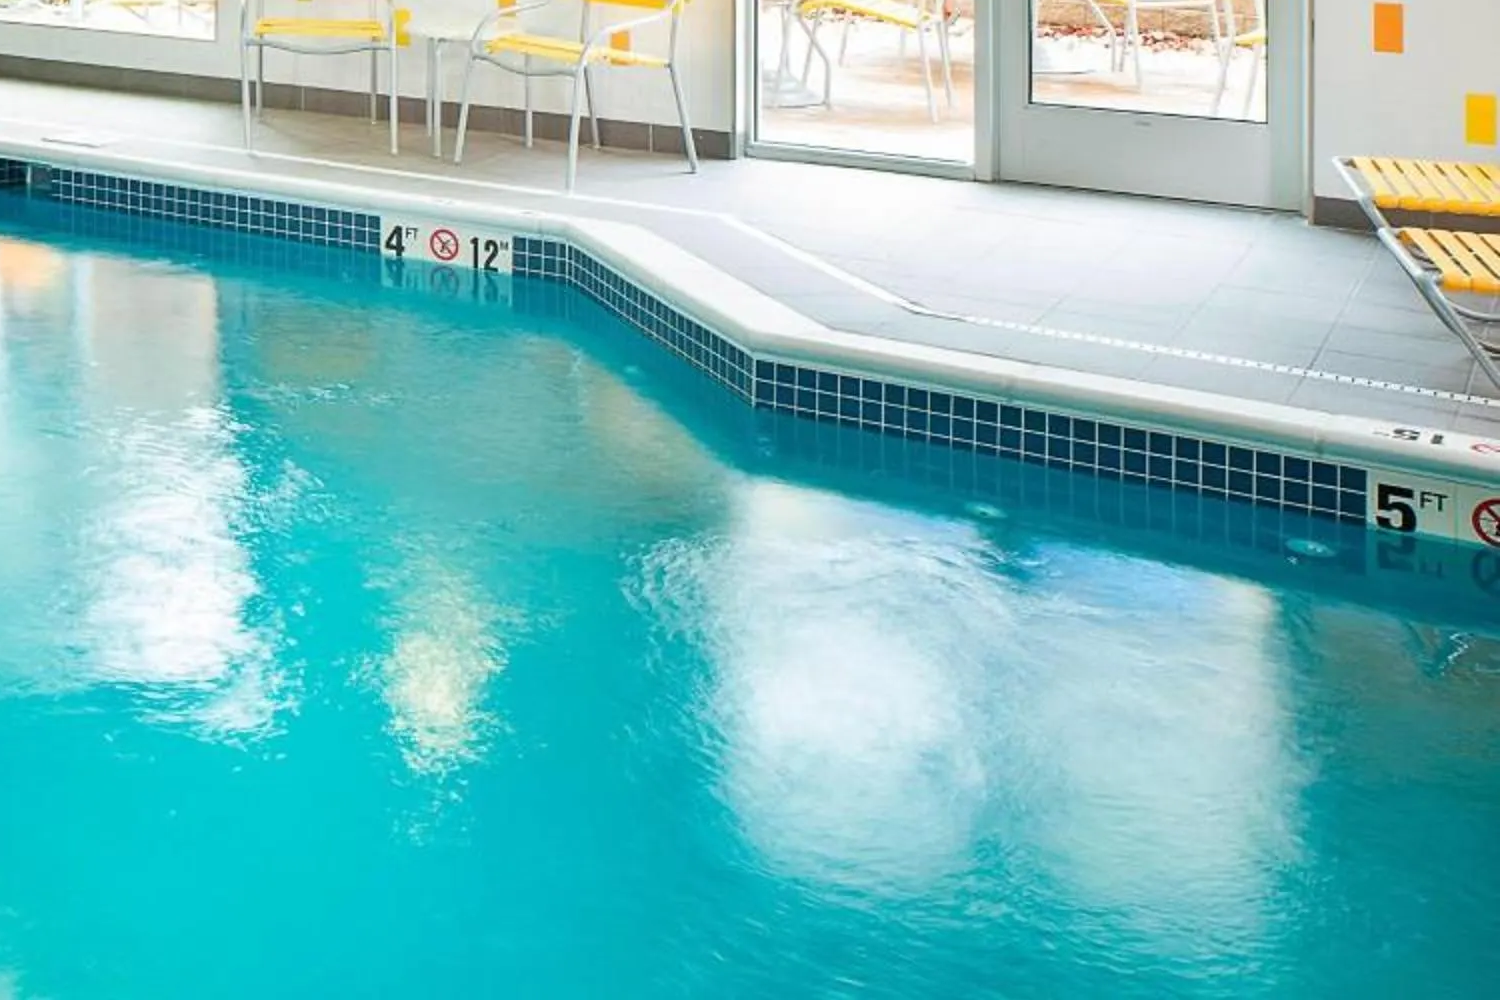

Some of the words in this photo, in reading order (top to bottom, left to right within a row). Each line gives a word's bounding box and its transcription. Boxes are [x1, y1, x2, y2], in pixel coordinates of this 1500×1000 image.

[385, 225, 405, 257] 4
[1375, 483, 1417, 532] 5
[1420, 491, 1448, 511] FT
